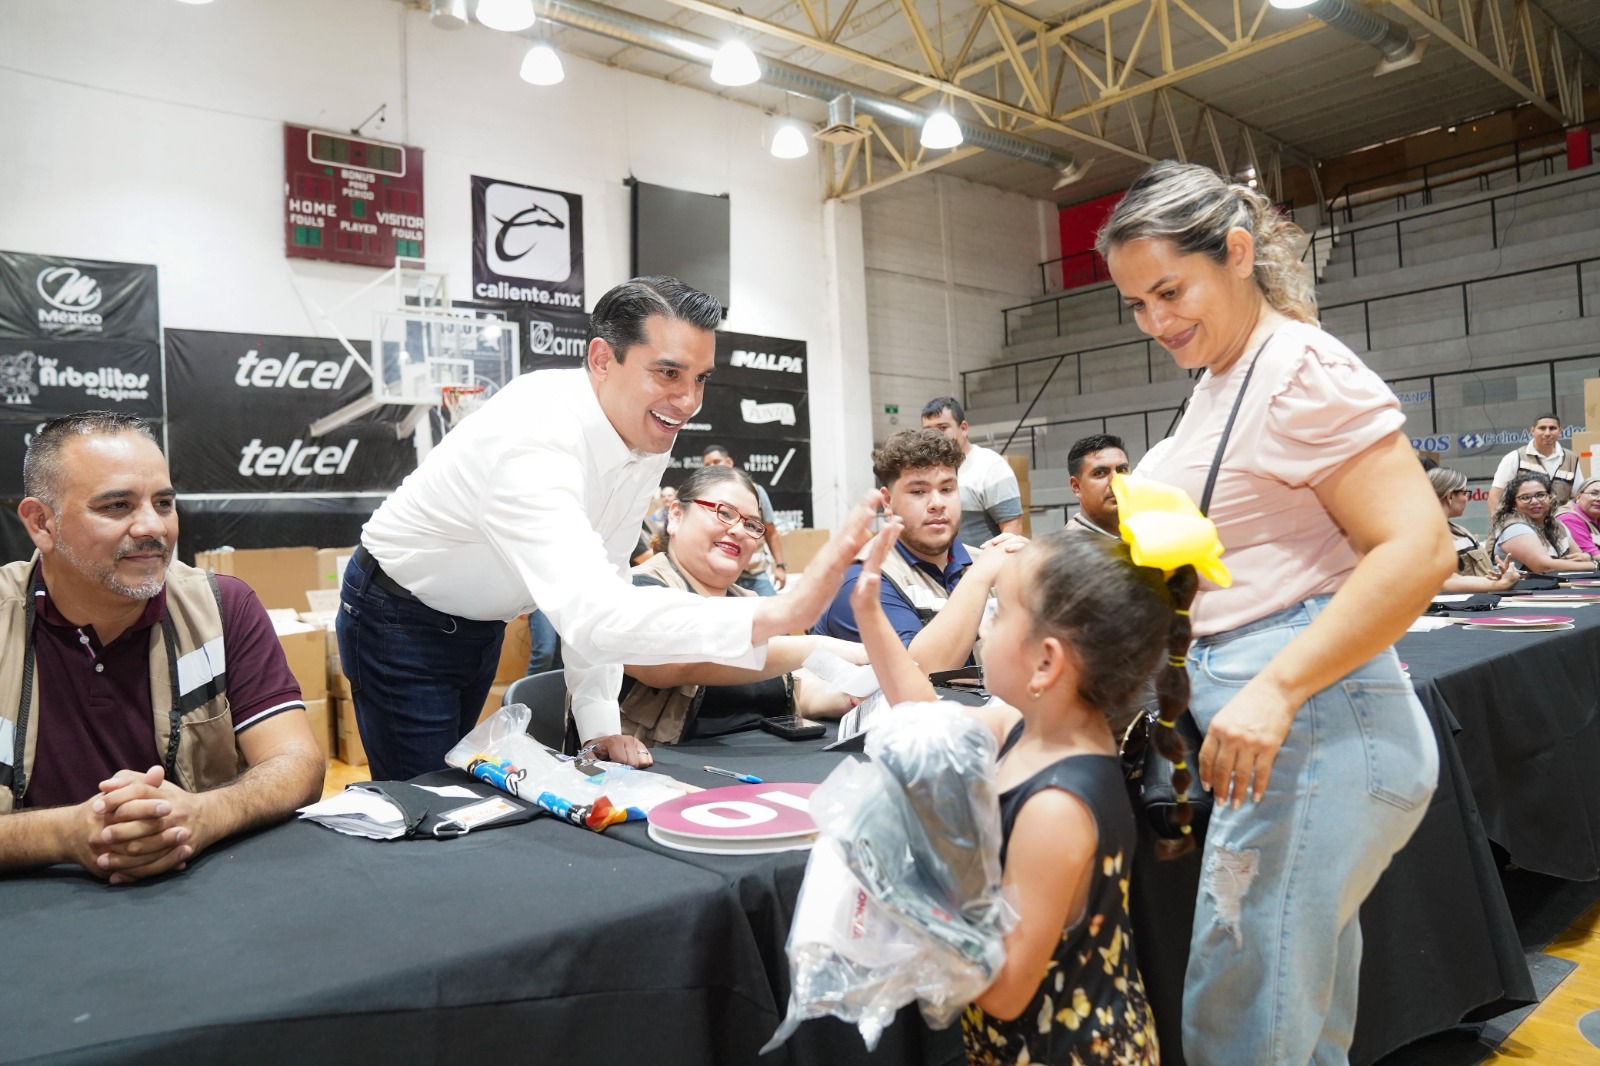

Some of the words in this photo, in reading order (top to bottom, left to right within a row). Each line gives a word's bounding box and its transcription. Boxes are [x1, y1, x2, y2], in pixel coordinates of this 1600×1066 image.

[340, 168, 376, 184] BONUS
[341, 187, 375, 201] PERIOD
[289, 198, 337, 217] HOME
[290, 213, 325, 228] FOULS
[340, 220, 378, 234] PLAYER
[376, 211, 424, 229] VISITOR
[392, 227, 423, 241] FOULS
[475, 281, 583, 308] caliente.mx
[234, 349, 355, 390] telcel
[730, 350, 803, 374] MALPA
[38, 366, 150, 390] Arbolitos
[98, 387, 148, 402] Cajeme
[1484, 431, 1518, 444] Cacho
[238, 439, 359, 476] telcel
